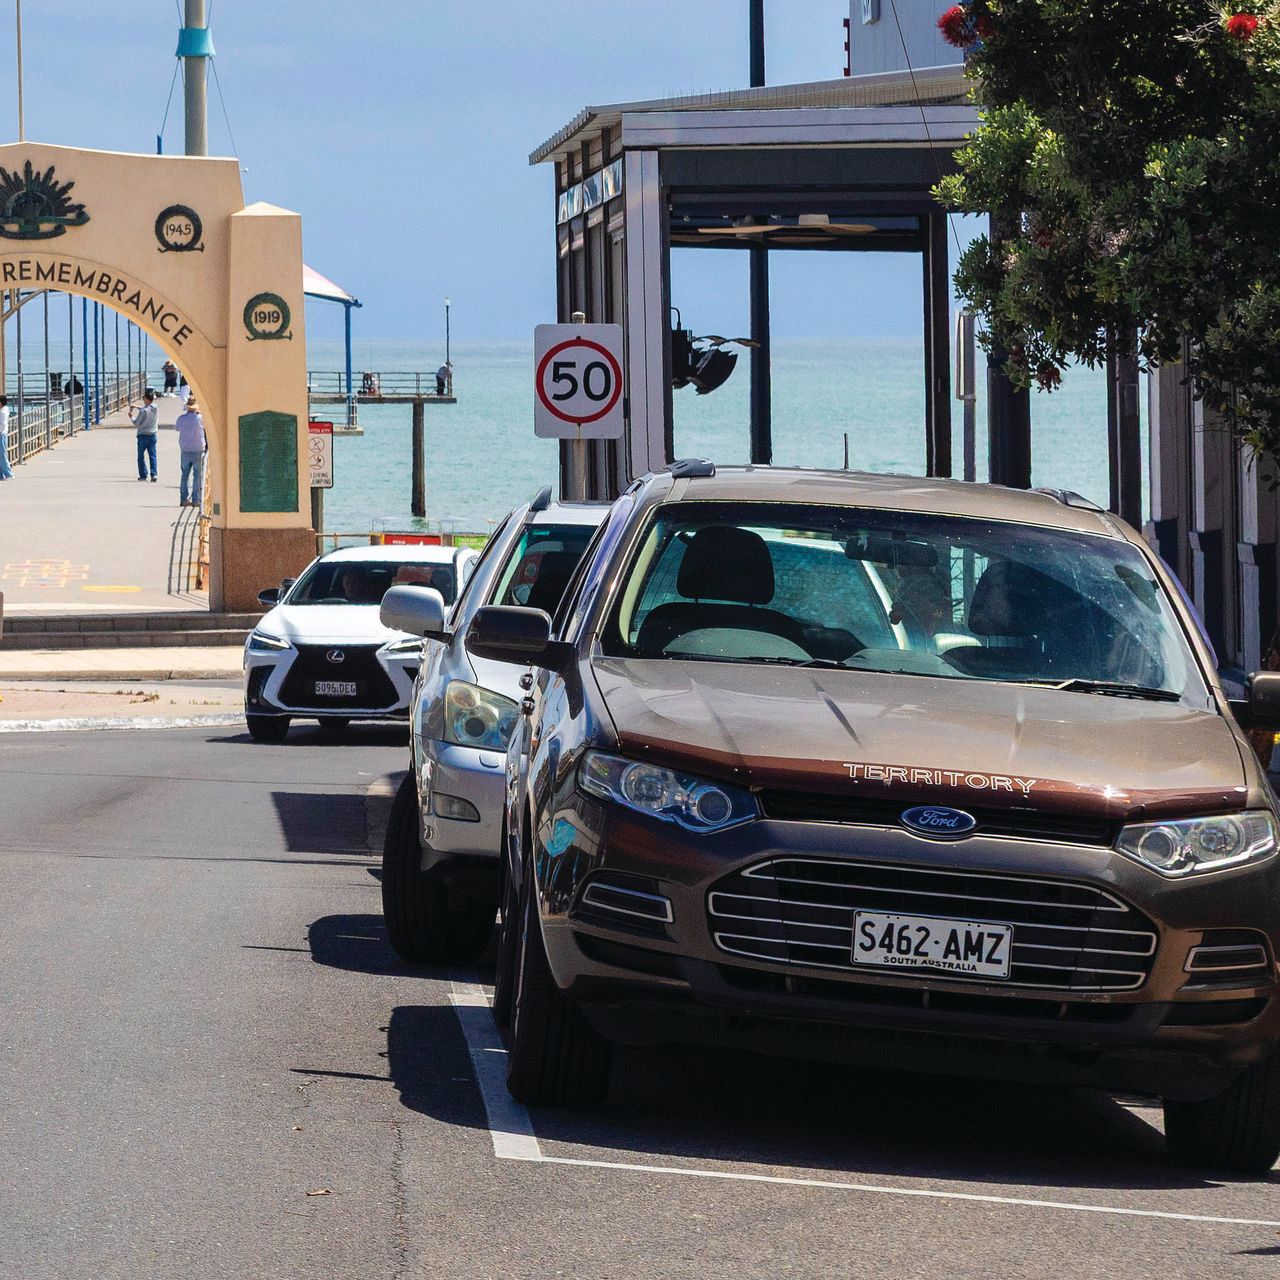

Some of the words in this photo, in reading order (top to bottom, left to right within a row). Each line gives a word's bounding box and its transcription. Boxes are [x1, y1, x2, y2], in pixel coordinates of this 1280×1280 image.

[165, 223, 192, 237] 1945
[2, 260, 194, 347] REMEMBRANCE
[254, 310, 280, 324] 1919
[551, 361, 612, 401] 50
[842, 763, 1037, 794] TERRITORY
[918, 810, 960, 828] Ford
[882, 955, 918, 966] SOUTH
[921, 958, 978, 972] AUSTRALIA
